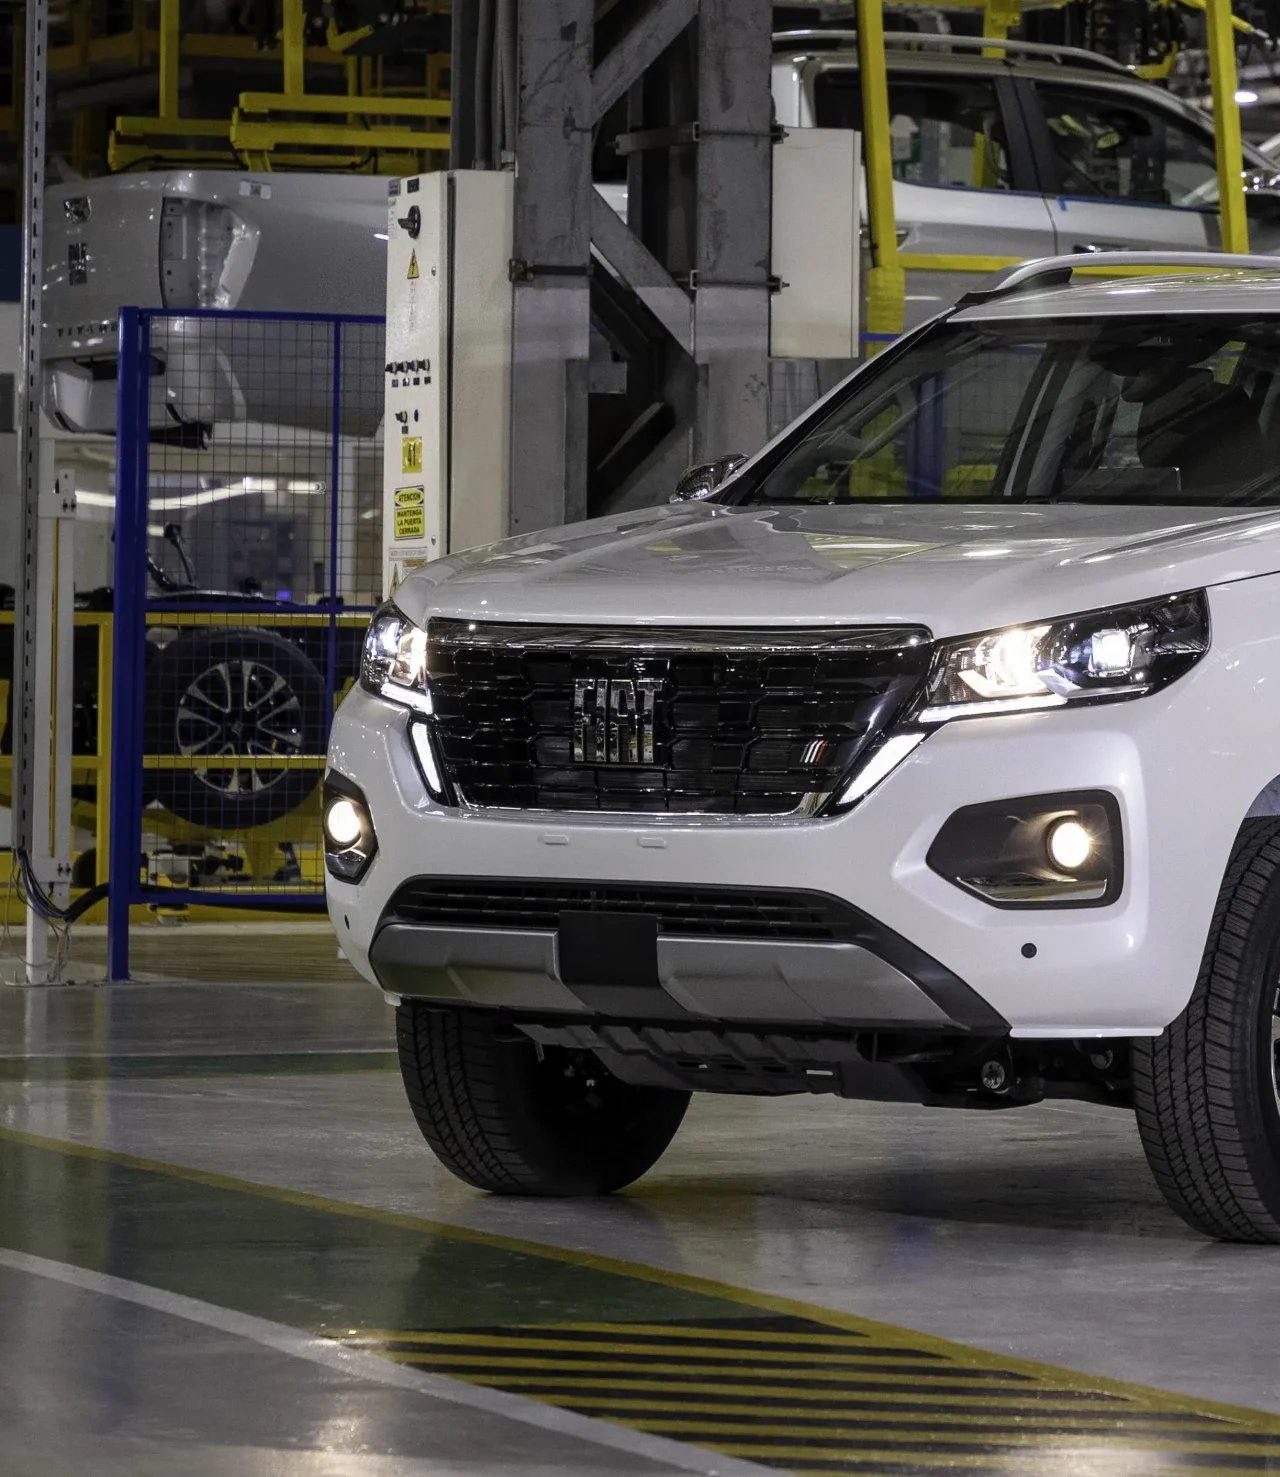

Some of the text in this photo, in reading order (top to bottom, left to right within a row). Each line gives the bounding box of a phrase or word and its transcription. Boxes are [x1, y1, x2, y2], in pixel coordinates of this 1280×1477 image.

[397, 509, 422, 517] MANTENGA
[404, 518, 422, 526] PUERTA
[399, 527, 420, 535] CERRADA
[574, 678, 663, 763] FIAT
